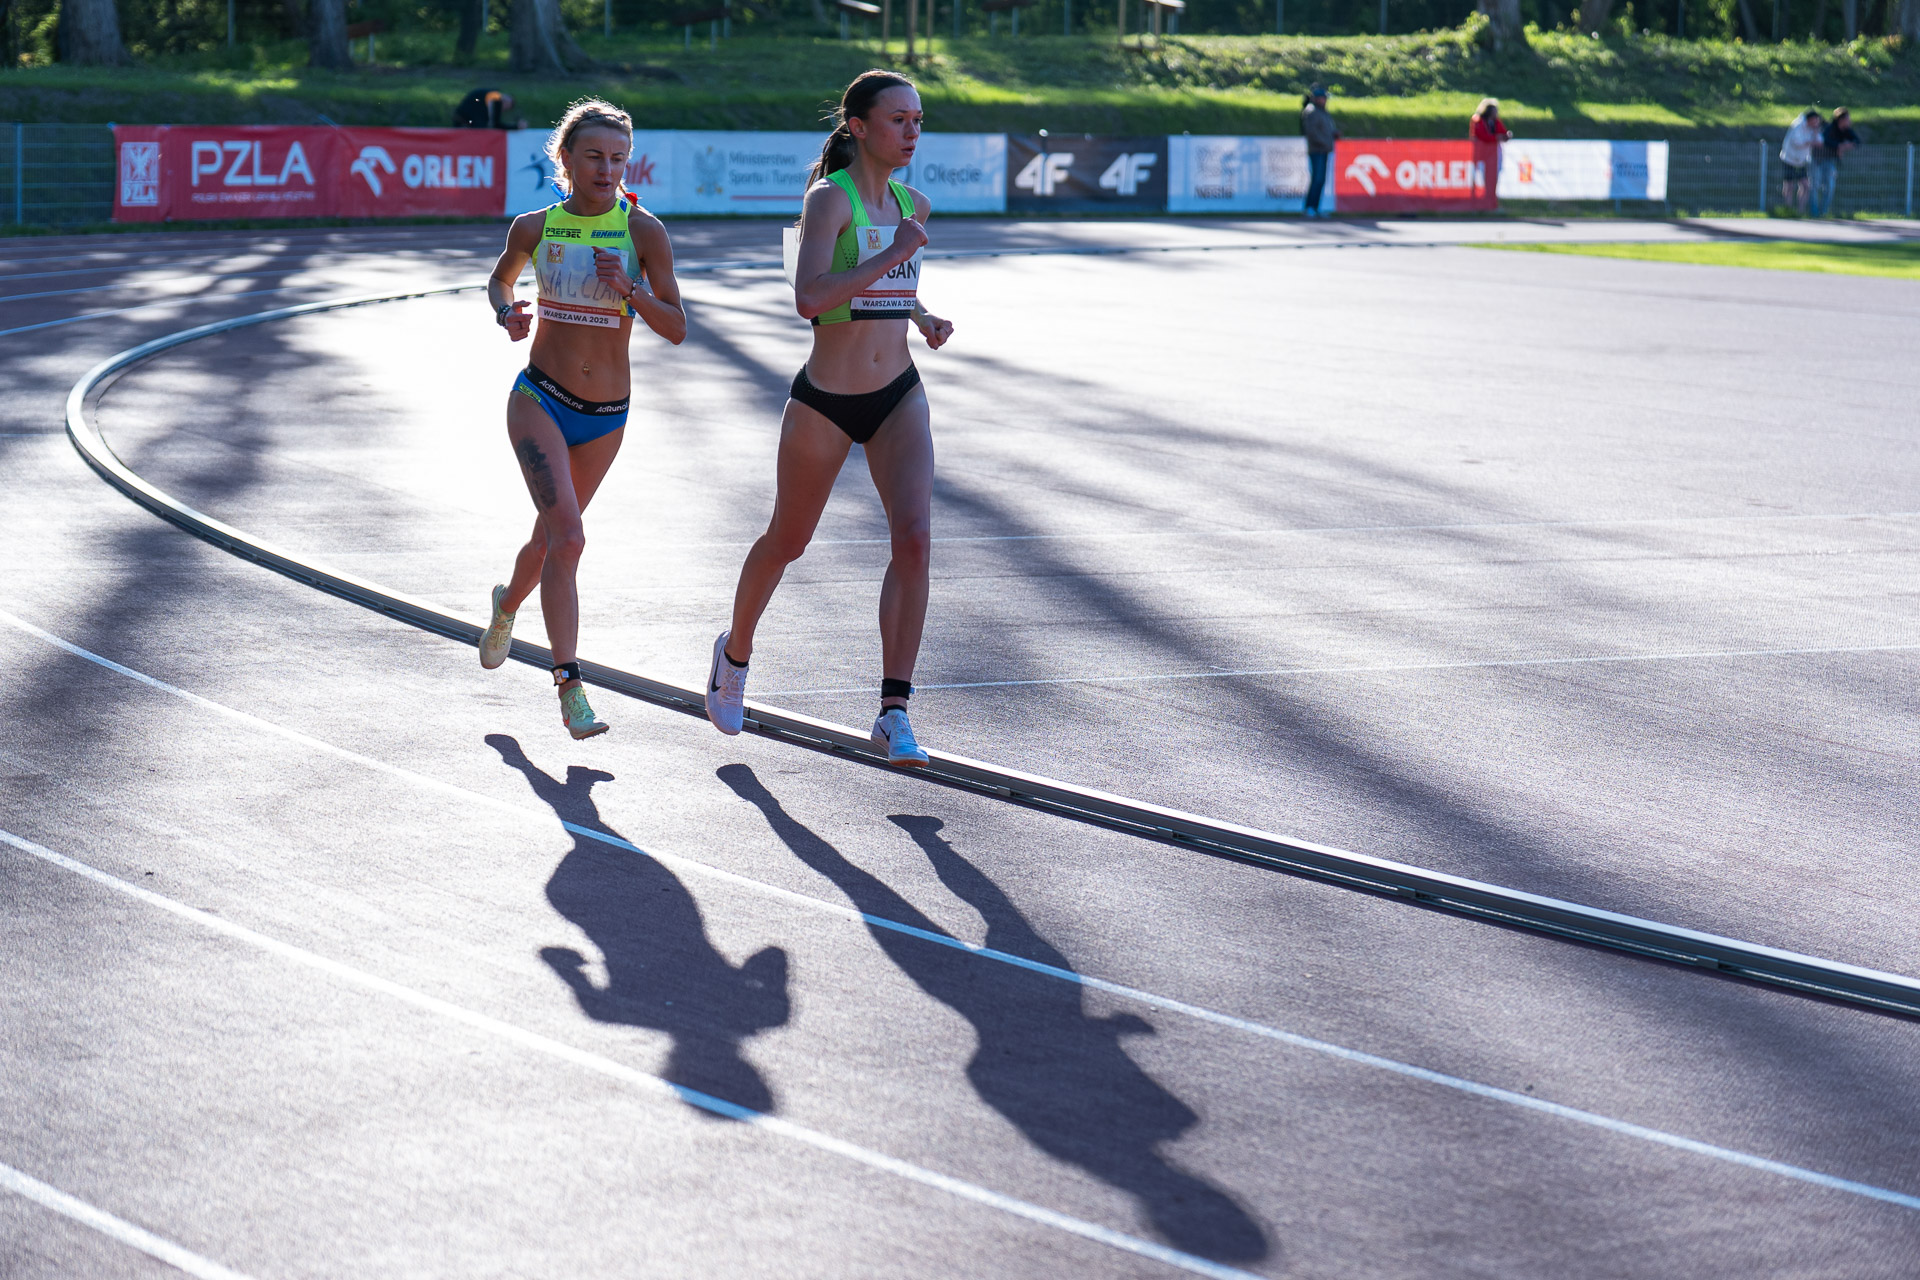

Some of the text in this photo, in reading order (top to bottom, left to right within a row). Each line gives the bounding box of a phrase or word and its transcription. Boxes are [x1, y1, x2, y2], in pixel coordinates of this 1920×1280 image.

[191, 140, 316, 187] PZLA
[728, 152, 797, 165] Ministerstwo
[402, 154, 494, 189] ORLEN
[728, 170, 763, 185] Sportu
[923, 163, 982, 184] Okęcie
[1015, 152, 1075, 196] 4F
[1098, 152, 1157, 195] 4F
[1395, 160, 1485, 189] ORLEN
[125, 186, 156, 201] PZLA
[880, 261, 917, 279] GAN
[543, 309, 609, 325] WARSZAWA 2025
